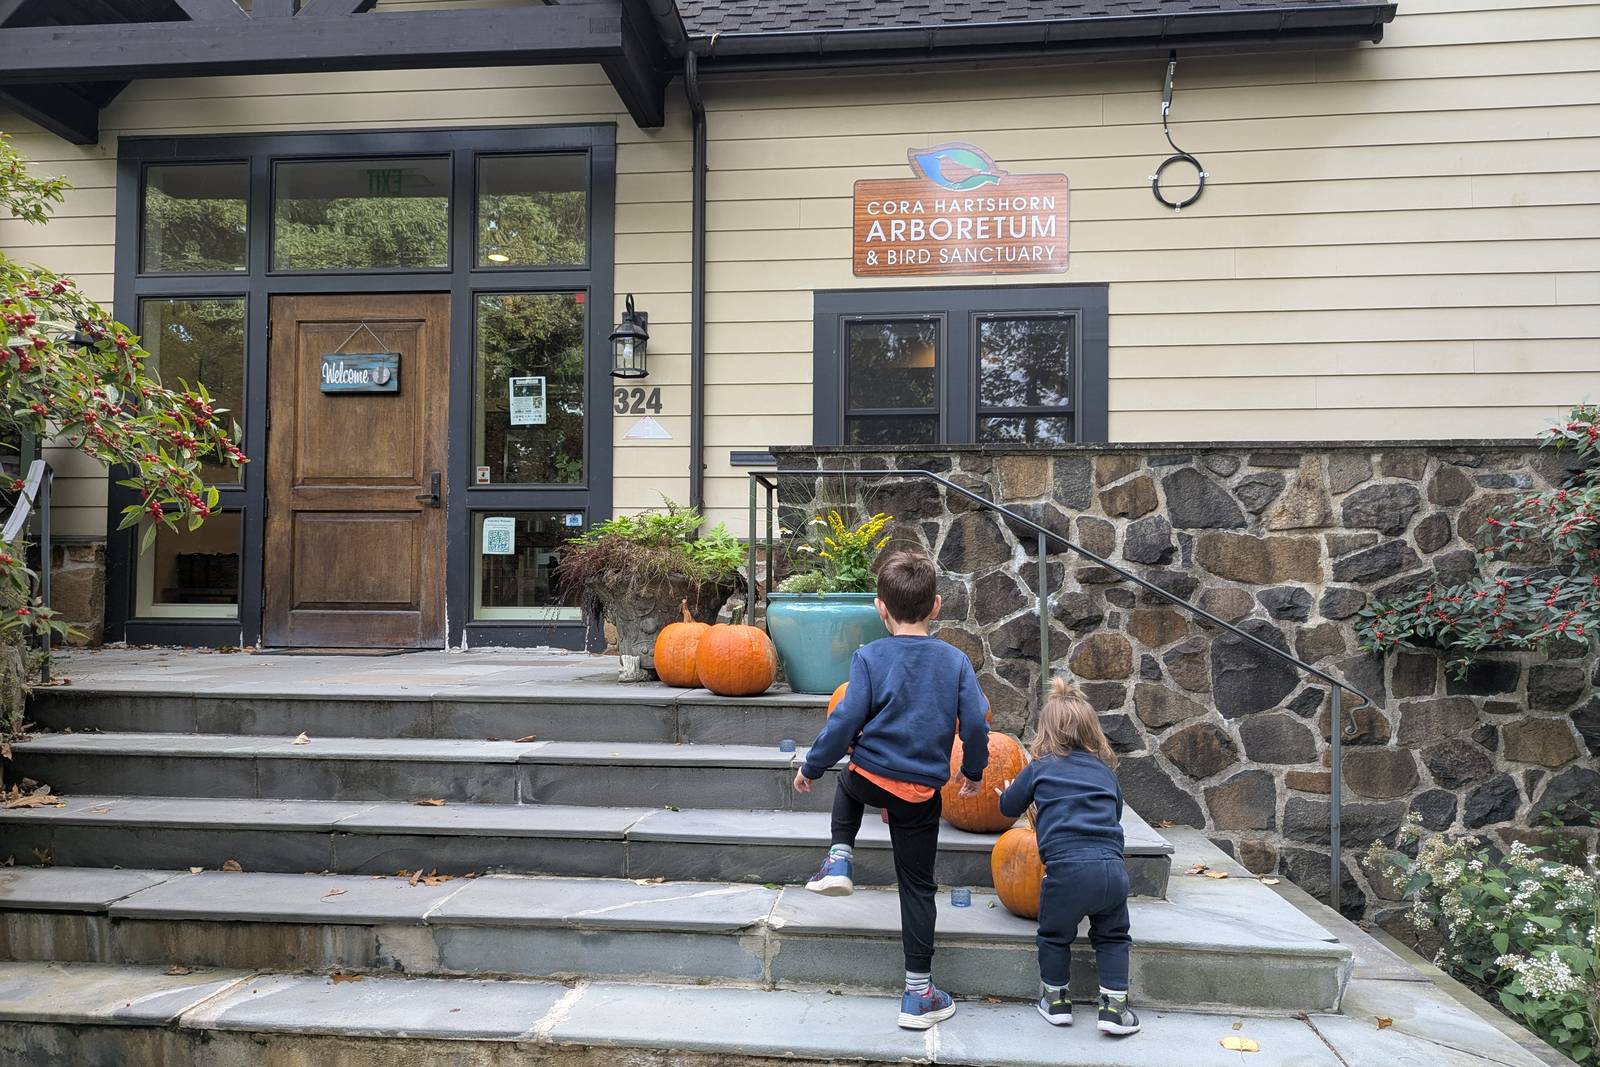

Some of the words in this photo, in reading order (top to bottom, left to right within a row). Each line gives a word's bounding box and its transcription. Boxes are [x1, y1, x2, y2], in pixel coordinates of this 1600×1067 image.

[867, 201, 924, 215] CORA
[935, 196, 1055, 212] HARTSHORN
[866, 215, 1056, 242] ARBORETUM
[866, 250, 879, 266] &
[887, 248, 931, 265] BIRD
[939, 246, 1055, 263] SANCTUARY
[322, 360, 369, 384] Welcome
[614, 387, 663, 414] 324
